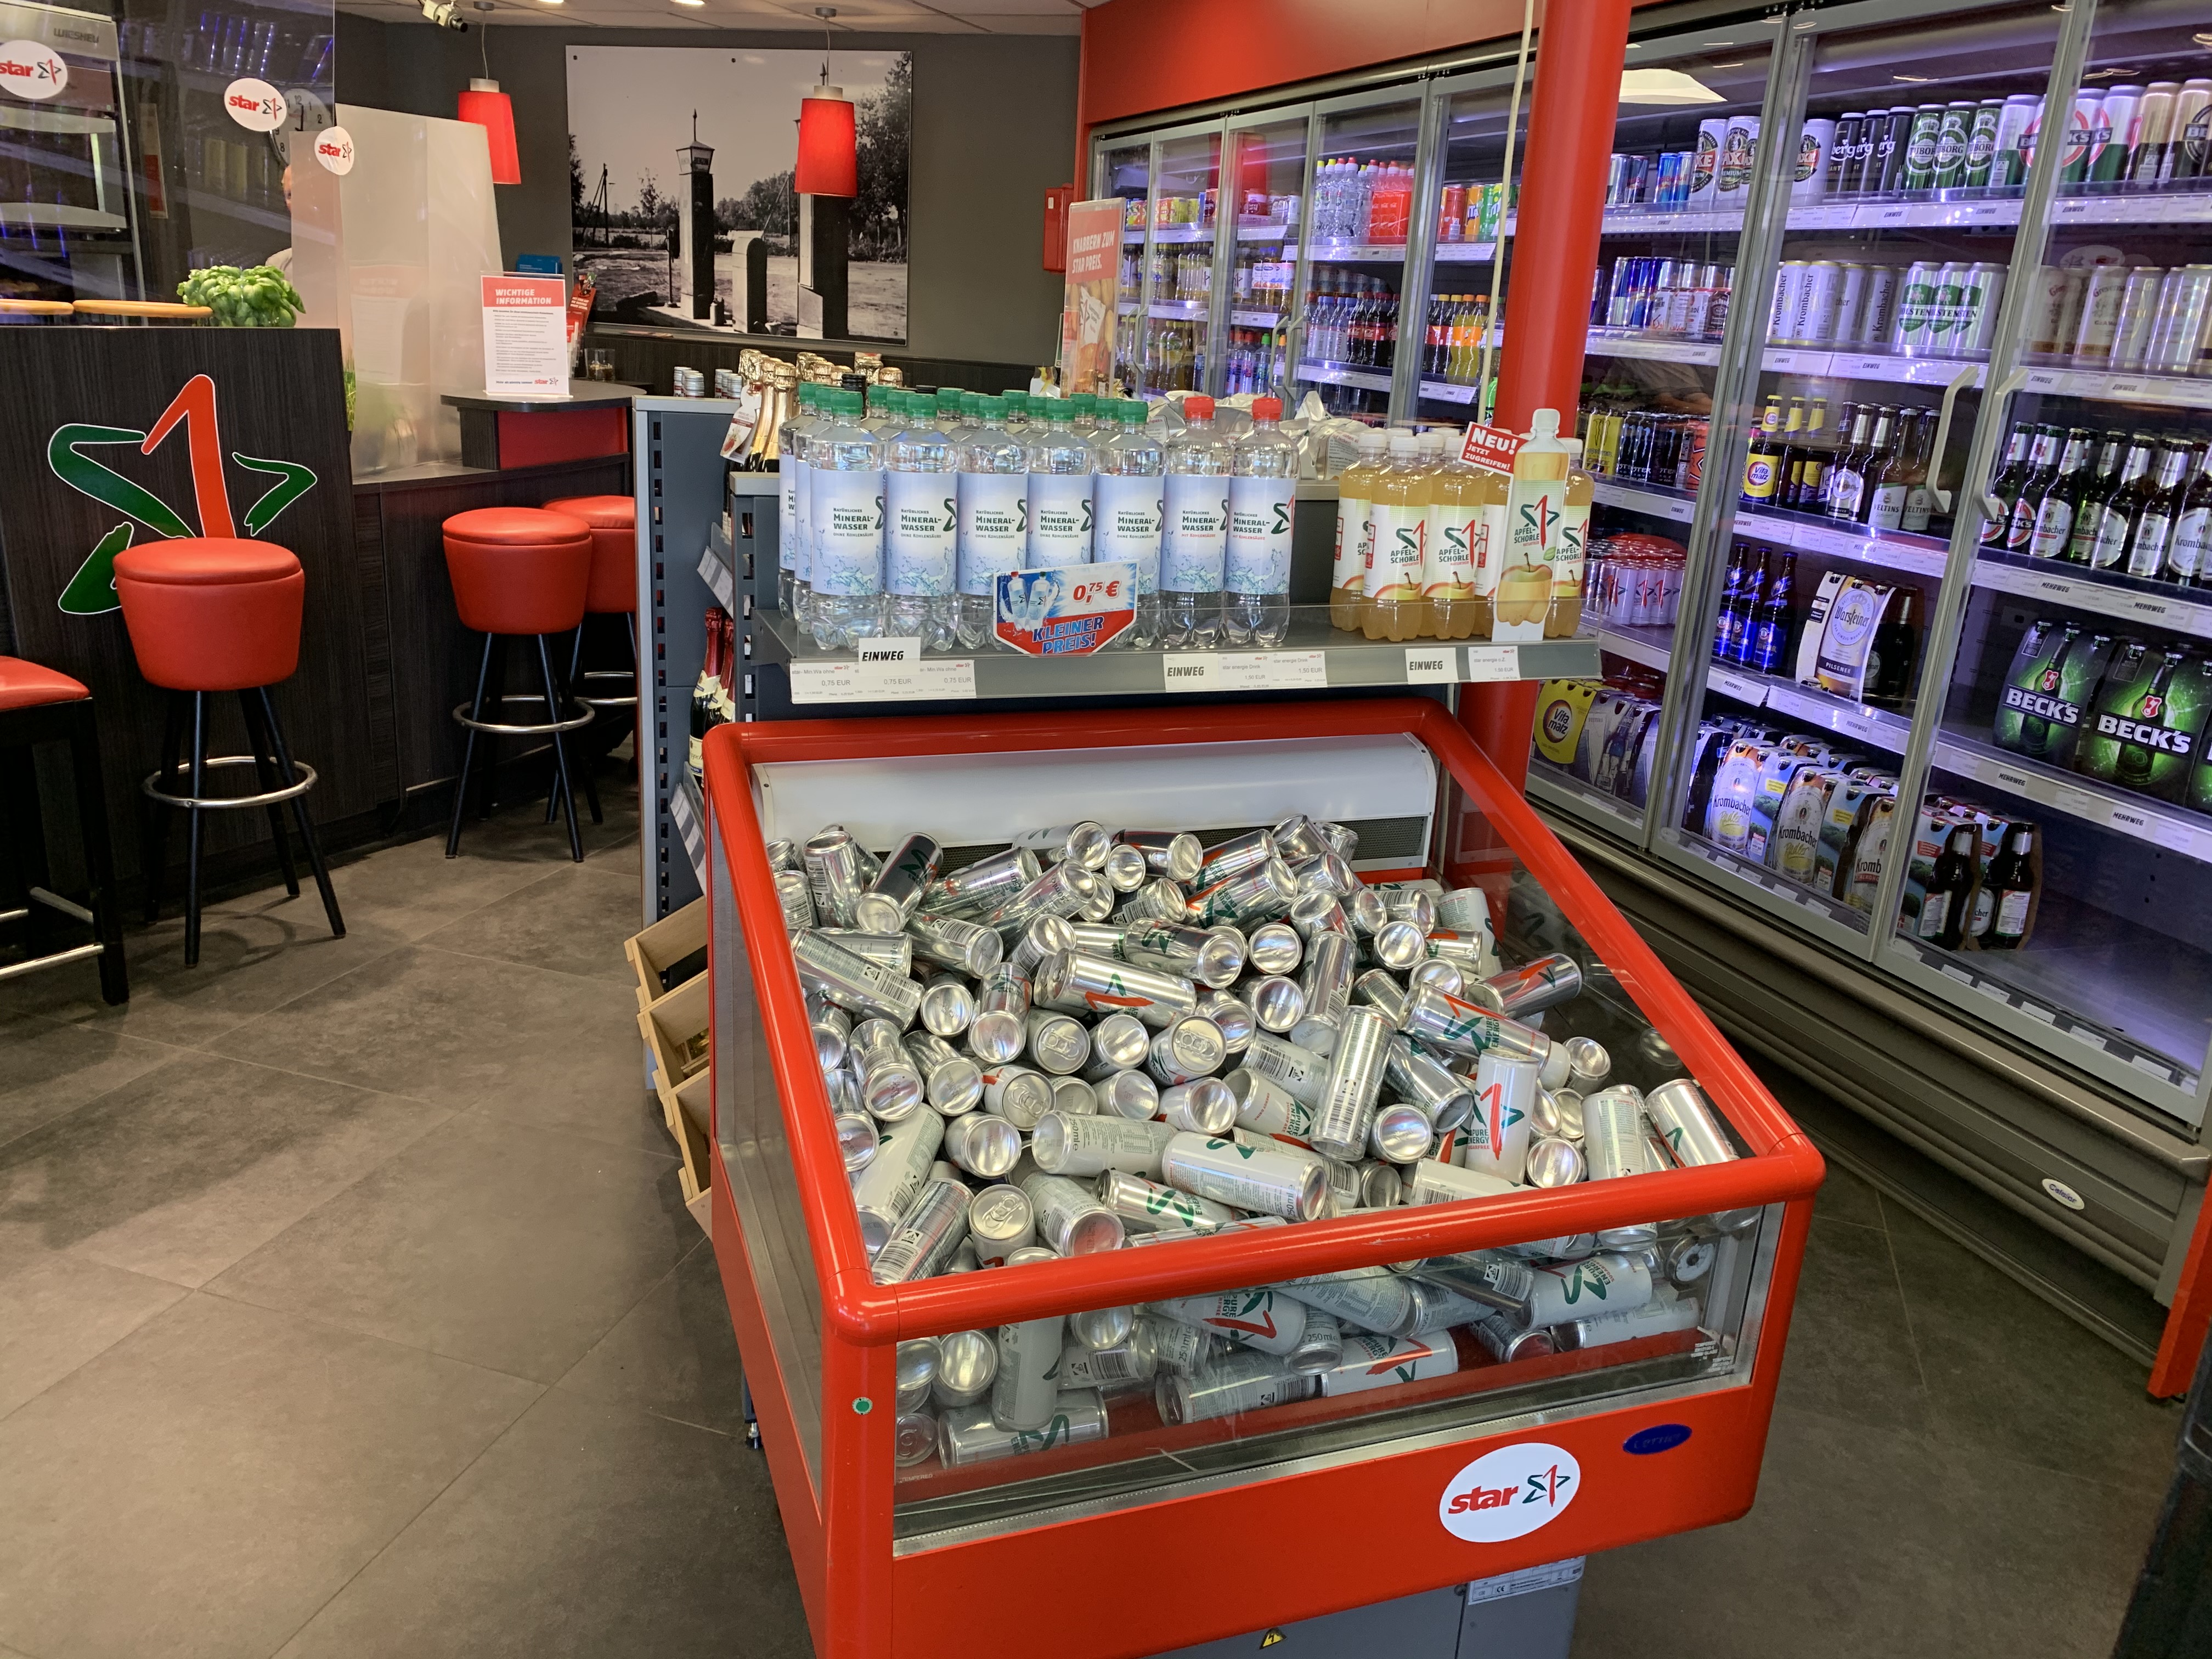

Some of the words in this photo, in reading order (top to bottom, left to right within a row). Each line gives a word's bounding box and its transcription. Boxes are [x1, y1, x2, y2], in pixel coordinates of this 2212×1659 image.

[0, 60, 33, 77] star
[228, 95, 259, 111] star
[318, 114, 323, 124] 2
[280, 142, 285, 152] 8
[318, 143, 341, 157] star
[1073, 233, 1101, 254] KNABBERN
[1102, 230, 1115, 248] ZUM
[1072, 257, 1085, 274] STAR
[1085, 253, 1102, 272] PREIS.
[1773, 273, 1787, 326] Krombacher
[1797, 273, 1814, 326] Krombacher
[1872, 279, 1893, 332] Krombacher
[2030, 375, 2054, 384] EINWEG
[2112, 383, 2138, 392] EINWEG
[1470, 427, 1518, 455] NEU!
[1467, 444, 1491, 456] JETZT
[1465, 453, 1511, 471] ZUGREIFEN!
[1750, 472, 1769, 481] malz
[1874, 504, 1900, 513] VELTINS
[833, 514, 874, 522] MINERAL-
[901, 515, 942, 523] MINERAL-
[975, 515, 1015, 524] MINERAL-
[1040, 515, 1080, 524] MINERAL-
[1118, 516, 1155, 524] MINERAL-
[1182, 516, 1220, 524] MINERAL-
[1233, 517, 1271, 526] MINERAL-
[1514, 527, 1536, 537] APFEL-
[1514, 533, 1540, 544] SCHORLE
[1390, 548, 1416, 557] APFEL-
[1556, 547, 1580, 555] APFEL-
[1556, 552, 1583, 562] SCHORLE
[1390, 554, 1420, 563] SCHORLE
[1438, 554, 1469, 563] SCHORLE
[1105, 580, 1120, 598] €
[2040, 582, 2071, 594] MEHRWEG
[2134, 602, 2166, 614] MEHRWEG
[1835, 605, 1870, 628] Warsteiner
[1032, 616, 1105, 643] KLEINER
[1042, 632, 1097, 654] PREIS!
[862, 650, 905, 662] EINWEG
[1167, 666, 1205, 677] EINWEG
[1409, 660, 1443, 671] EINWEG
[1825, 661, 1852, 675] PILSENER
[1723, 679, 1743, 692] MEHRWEG
[2005, 687, 2080, 725] BECK'S
[1553, 708, 1570, 724] Vita
[1548, 719, 1569, 736] malz
[1846, 719, 1869, 733] MEHRWEG
[2097, 714, 2192, 755] BECK'S
[1998, 772, 2027, 787] MEHRWEG
[1713, 794, 1752, 816] Krombacher
[2112, 811, 2145, 826] MEHRWEG
[1778, 825, 1818, 849] Krombacher
[1485, 1015, 1493, 1037] PURE
[1286, 1103, 1295, 1136] ENERGY
[1448, 1486, 1519, 1514] star
